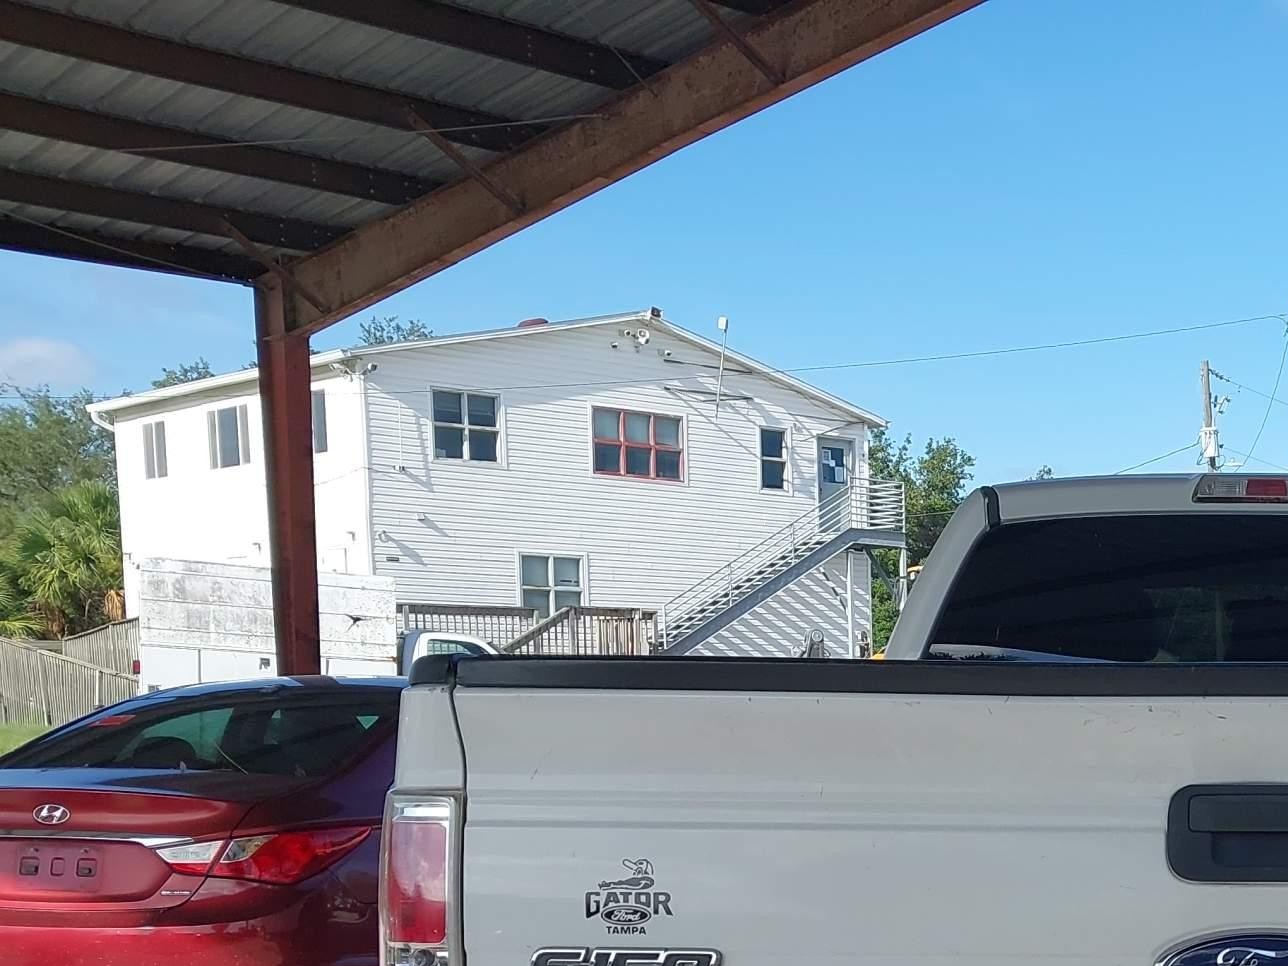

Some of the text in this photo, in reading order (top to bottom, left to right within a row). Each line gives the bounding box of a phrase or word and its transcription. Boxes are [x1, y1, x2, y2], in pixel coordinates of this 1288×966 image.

[585, 890, 674, 919] GATOR
[610, 908, 641, 922] Ford
[606, 926, 647, 935] TAMPA
